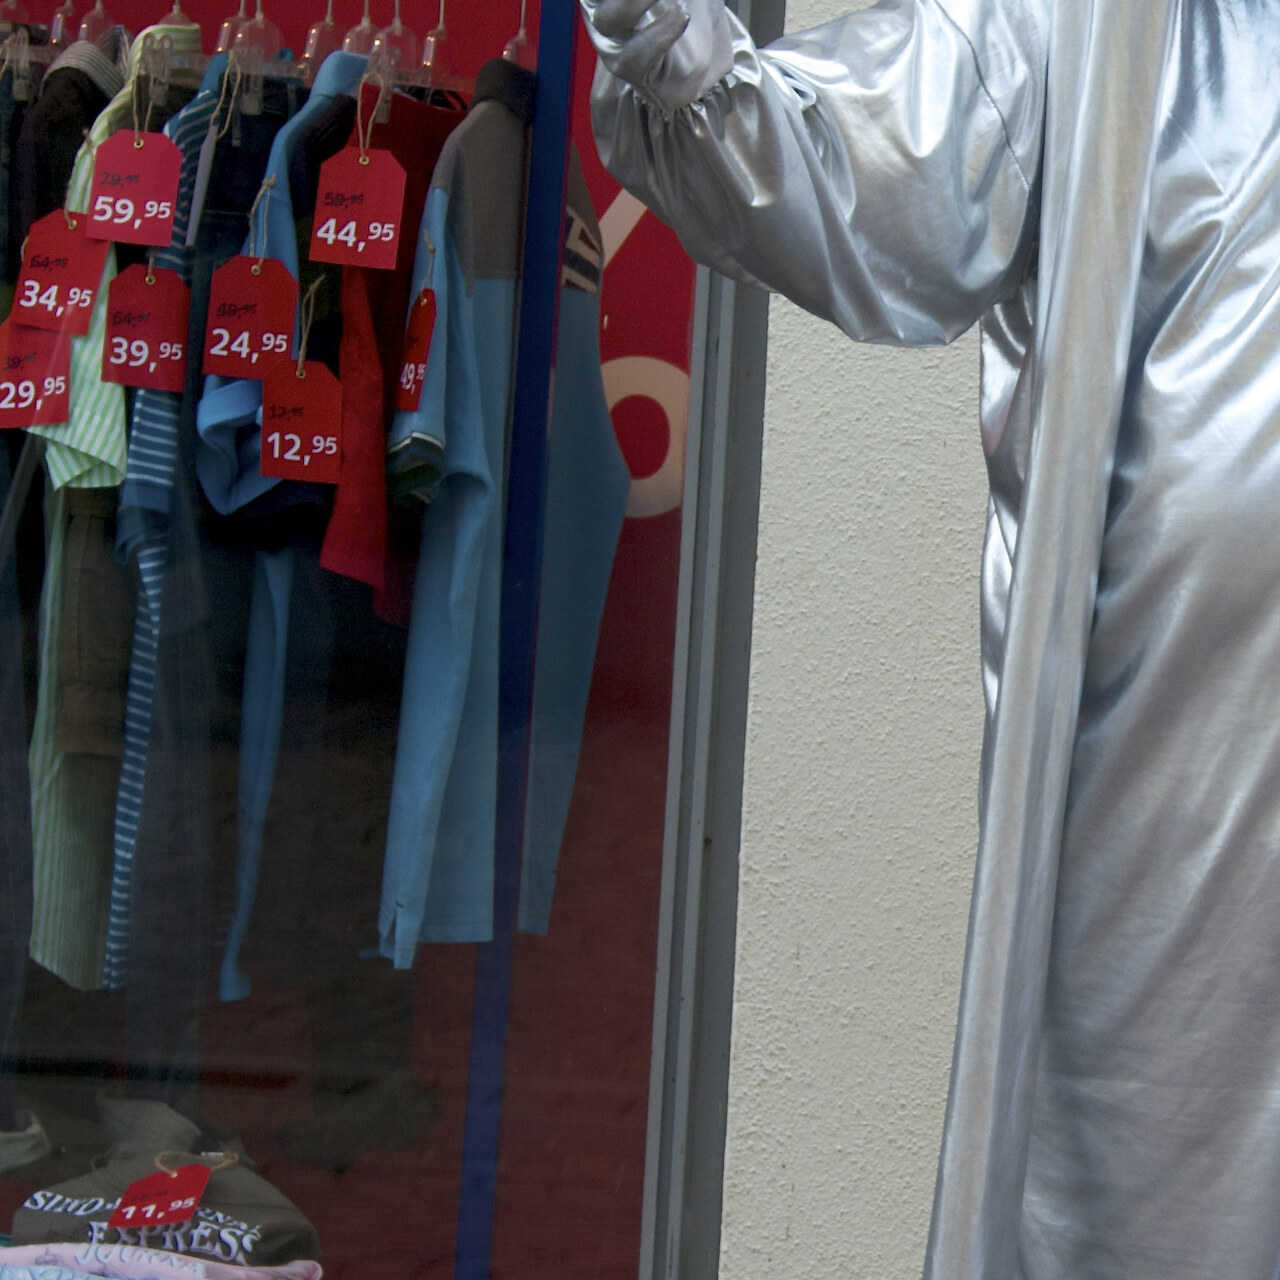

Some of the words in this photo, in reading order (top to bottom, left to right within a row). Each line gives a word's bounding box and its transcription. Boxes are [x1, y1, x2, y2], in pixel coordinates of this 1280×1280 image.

[93, 195, 171, 229] 59,95
[316, 218, 395, 253] 44,95
[19, 279, 92, 317] 34,95
[109, 337, 183, 373] 39,95
[209, 328, 288, 364] 24,95
[0, 375, 66, 410] 29,95
[267, 432, 337, 466] 12,95
[121, 1197, 195, 1219] 11,95
